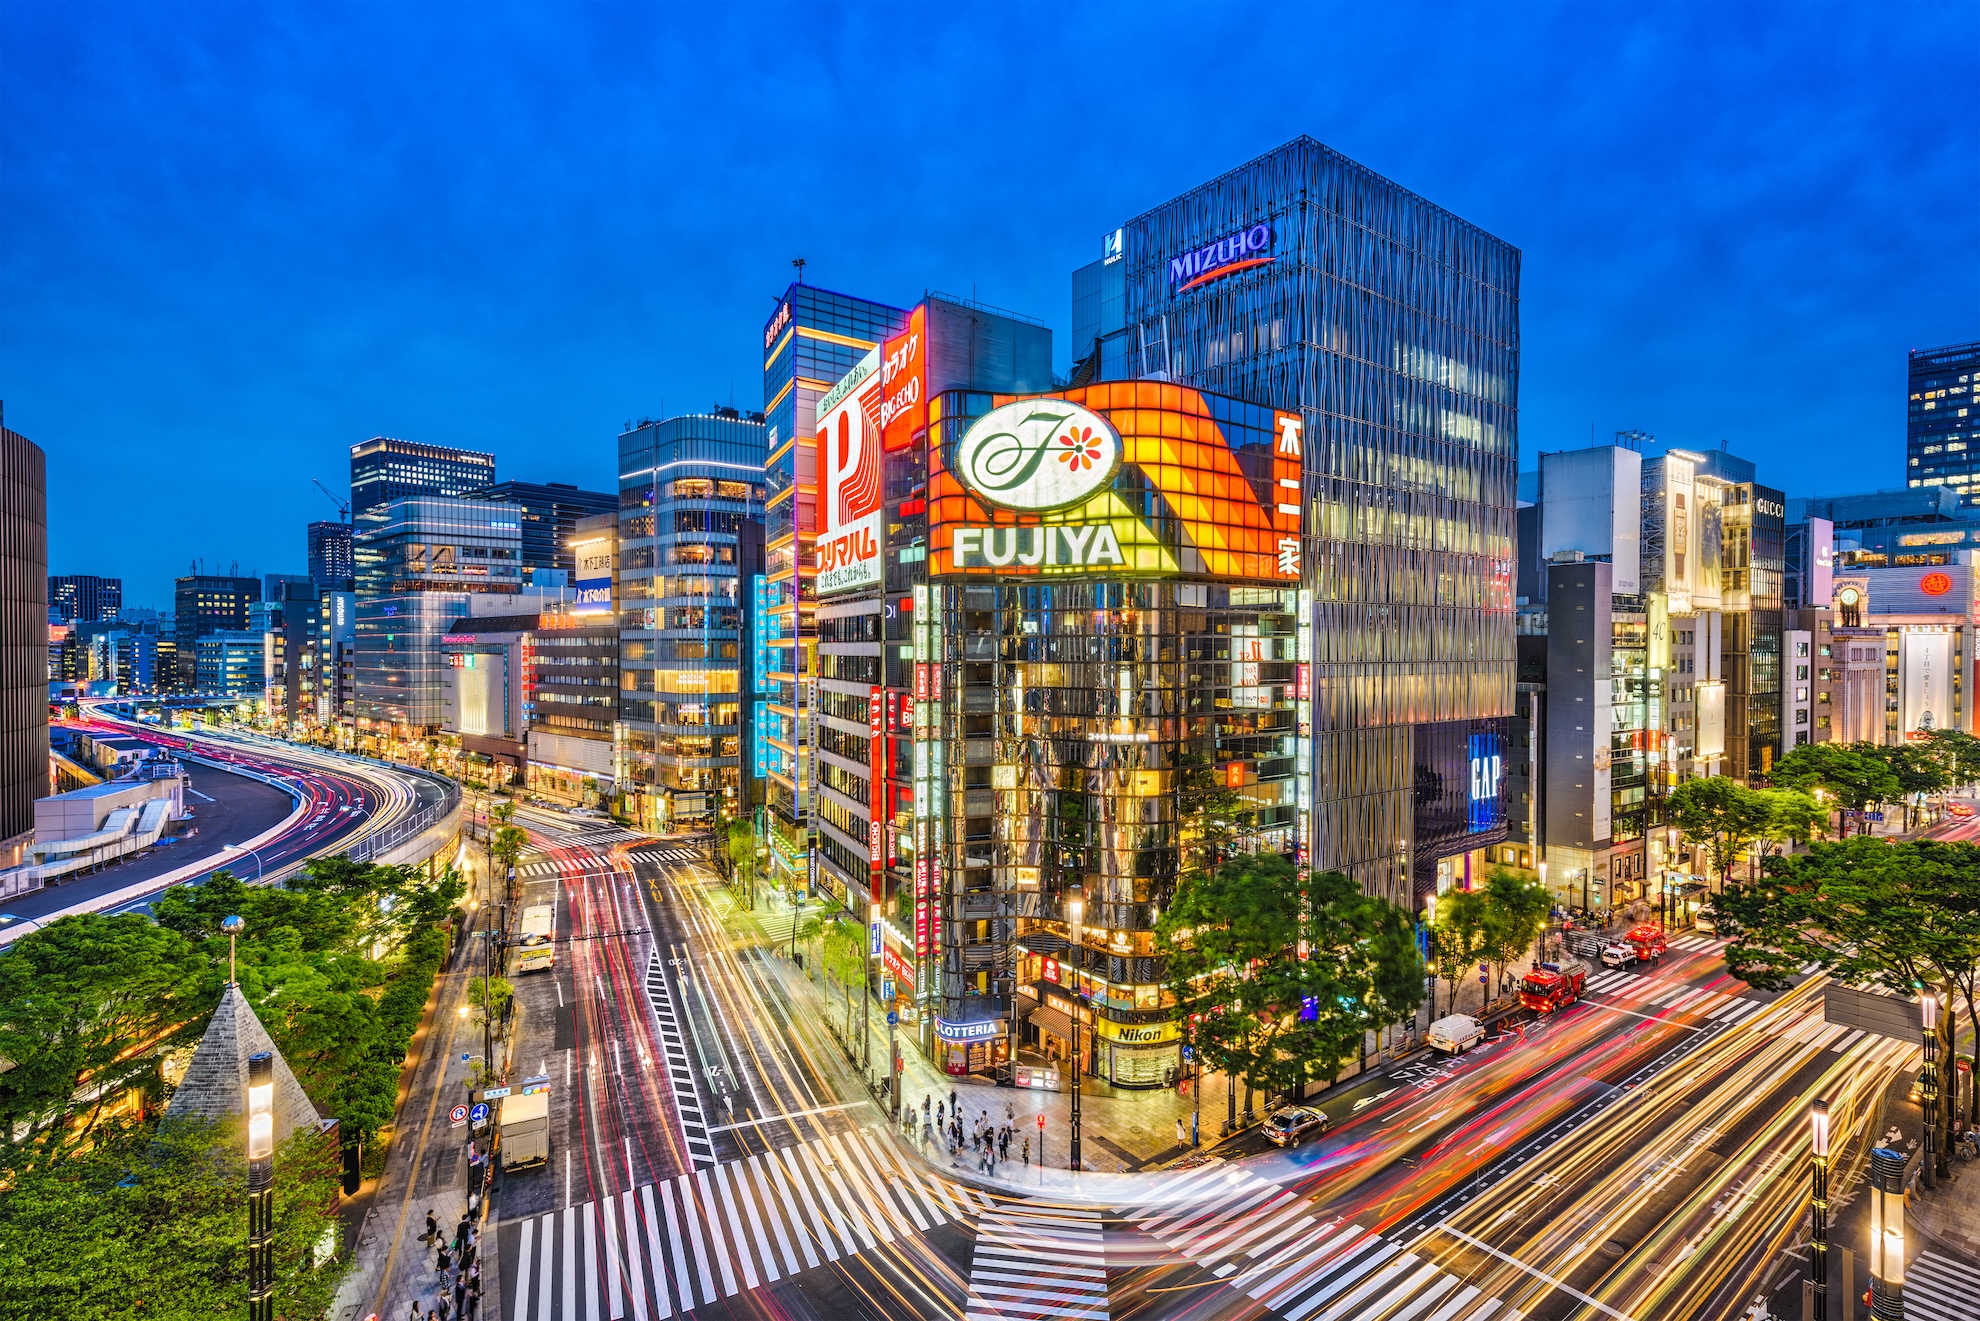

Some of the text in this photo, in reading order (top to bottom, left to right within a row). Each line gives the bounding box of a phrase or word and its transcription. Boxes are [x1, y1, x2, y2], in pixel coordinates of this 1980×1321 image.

[1104, 253, 1122, 266] HULIC
[1170, 224, 1270, 285] MIZUHO
[882, 333, 919, 388] カラオケ
[881, 375, 920, 430] BIG ECHO
[1278, 416, 1301, 575] 不二家
[1757, 497, 1784, 518] GUCCI
[816, 526, 877, 574] プリマハム
[953, 525, 1124, 567] FUJIYA
[821, 562, 872, 588] これまでも、これからも。
[871, 693, 881, 738] カラオケ
[1231, 765, 1239, 784] 焼肉
[1471, 755, 1500, 800] GAP
[871, 820, 880, 861] BIG ECHO
[918, 910, 926, 943] 不二家
[940, 1022, 997, 1037] LOTTERIA
[1118, 1027, 1162, 1042] Nikon
